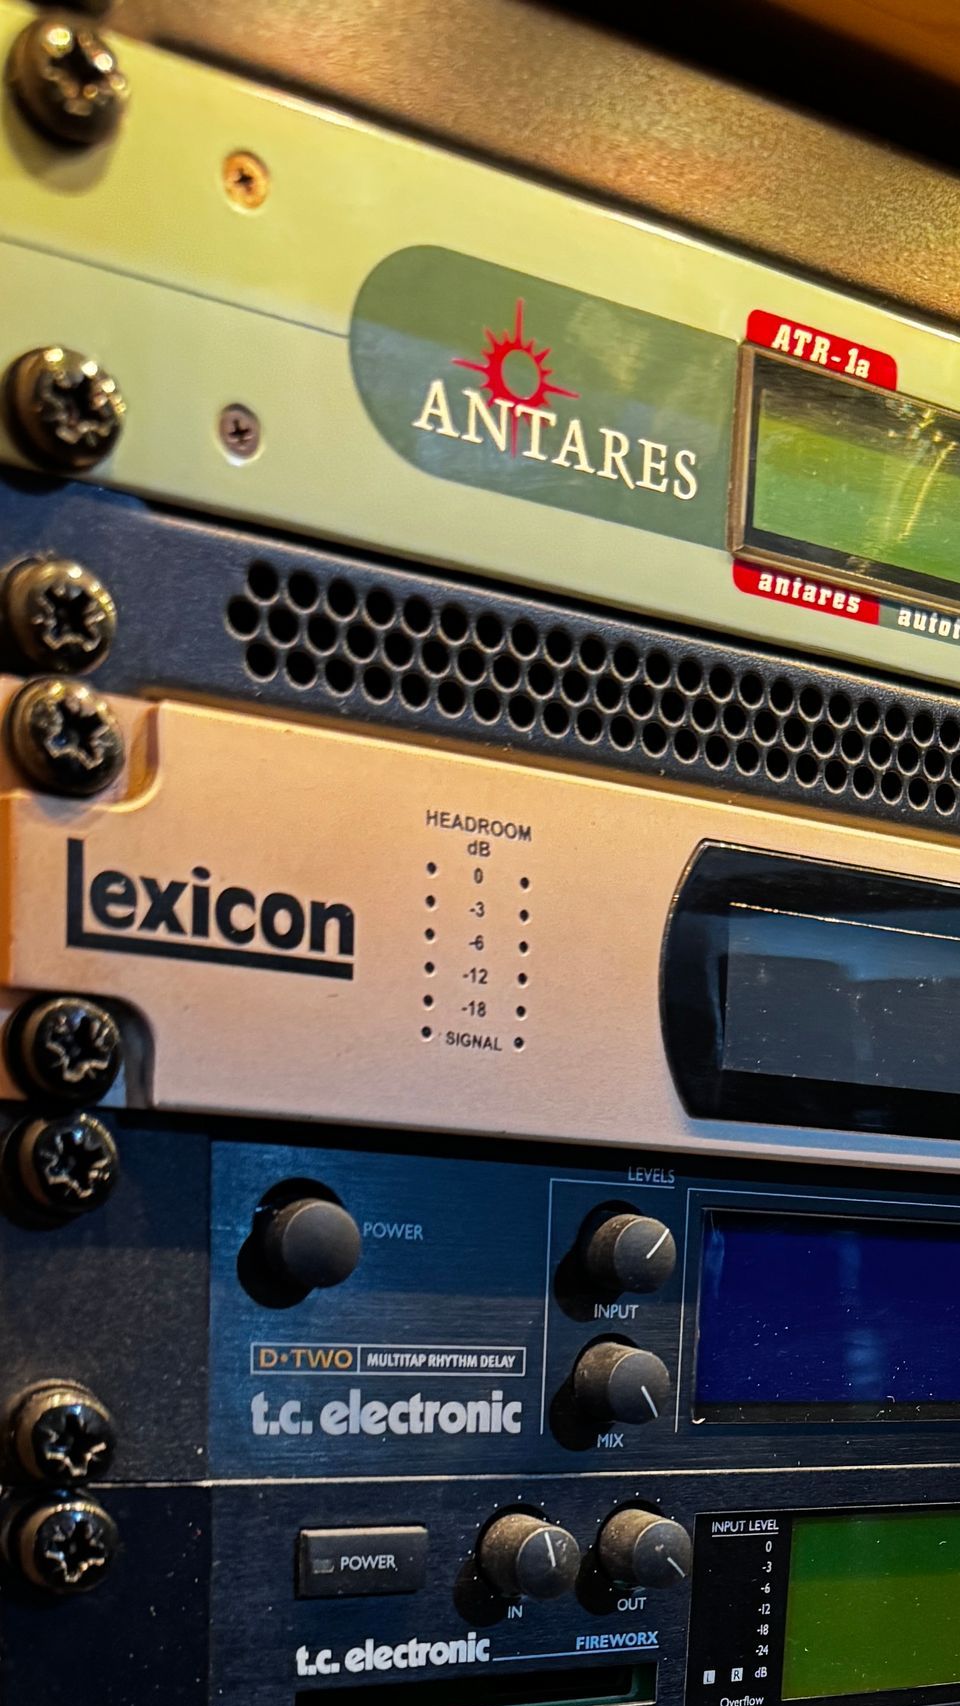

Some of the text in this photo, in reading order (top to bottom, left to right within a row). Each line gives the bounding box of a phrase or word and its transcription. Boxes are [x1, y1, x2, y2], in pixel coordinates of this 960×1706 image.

[772, 324, 870, 379] ATR-1a
[412, 379, 698, 501] ANTARES
[758, 571, 861, 614] antares
[426, 809, 532, 842] HEADROOM
[468, 840, 491, 858] dB
[67, 838, 354, 981] Lexicon
[463, 968, 488, 985] -12
[462, 1001, 487, 1018] -18
[445, 1031, 502, 1051] SIGNAL
[628, 1166, 675, 1184] LEVELS
[363, 1222, 423, 1241] POWER
[594, 1304, 638, 1319] INPUT
[367, 1353, 516, 1369] MULTITAP RHYTHM DELAY
[251, 1389, 521, 1435] t.c. electronic
[597, 1434, 623, 1448] MIX
[712, 1519, 779, 1533] INPUT LEVEL
[340, 1555, 395, 1570] POWER
[508, 1605, 522, 1619] IN
[617, 1597, 646, 1611] OUT
[758, 1604, 770, 1614] -12
[576, 1631, 659, 1651] FIREWORX
[296, 1632, 490, 1676] t.c. electronic
[756, 1645, 769, 1656] -24
[755, 1667, 767, 1678] dB
